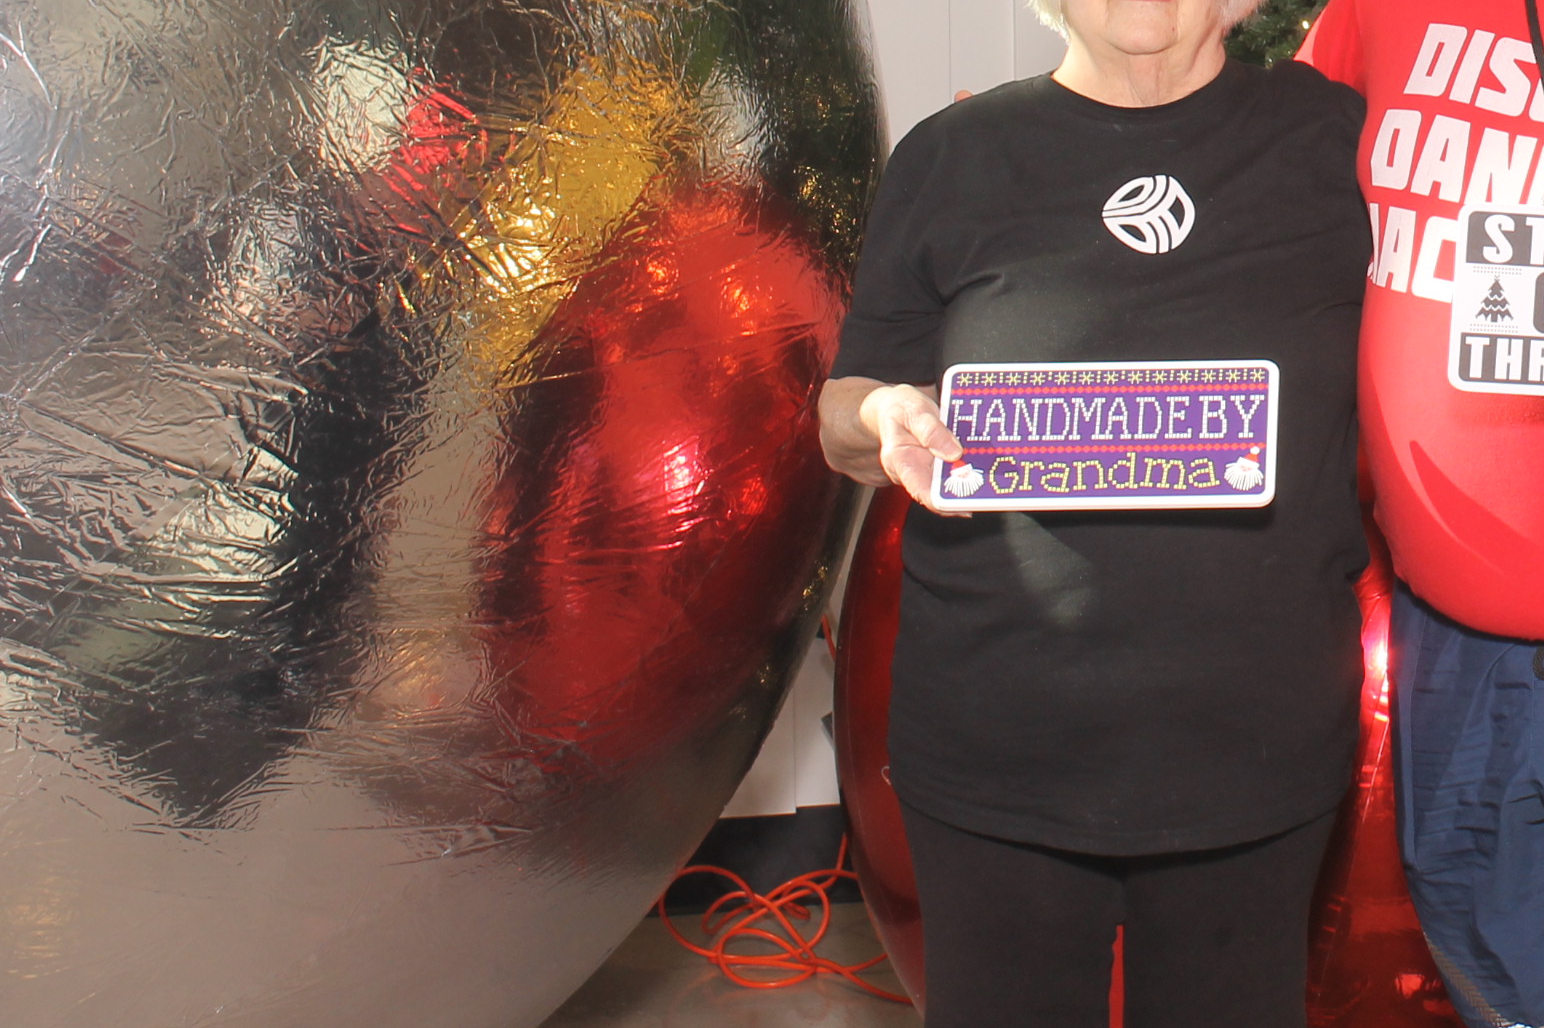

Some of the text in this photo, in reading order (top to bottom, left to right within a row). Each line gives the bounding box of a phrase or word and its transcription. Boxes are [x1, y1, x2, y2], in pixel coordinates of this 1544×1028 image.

[952, 394, 1265, 442] HANDMADE BY
[988, 451, 1221, 495] Grandma
